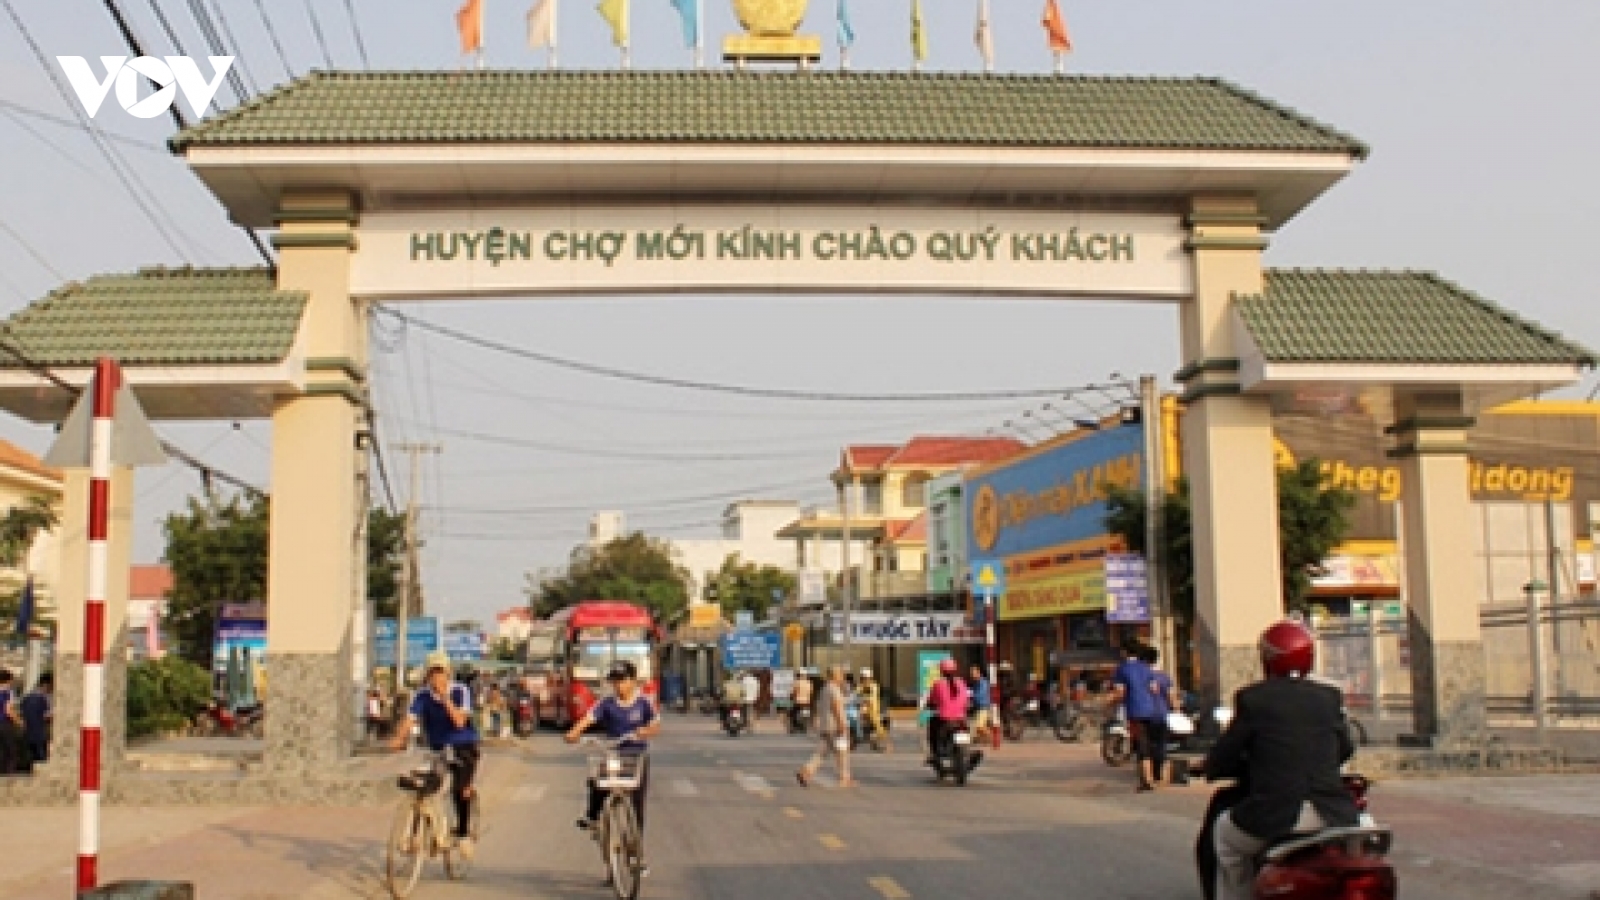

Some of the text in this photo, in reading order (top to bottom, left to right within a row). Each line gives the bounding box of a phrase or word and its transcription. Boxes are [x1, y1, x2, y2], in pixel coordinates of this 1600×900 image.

[409, 223, 1135, 268] HUYỆN CHỢ MỚI KÍNH CHÀO QUÝ KHÁCH
[915, 617, 950, 638] TÂY
